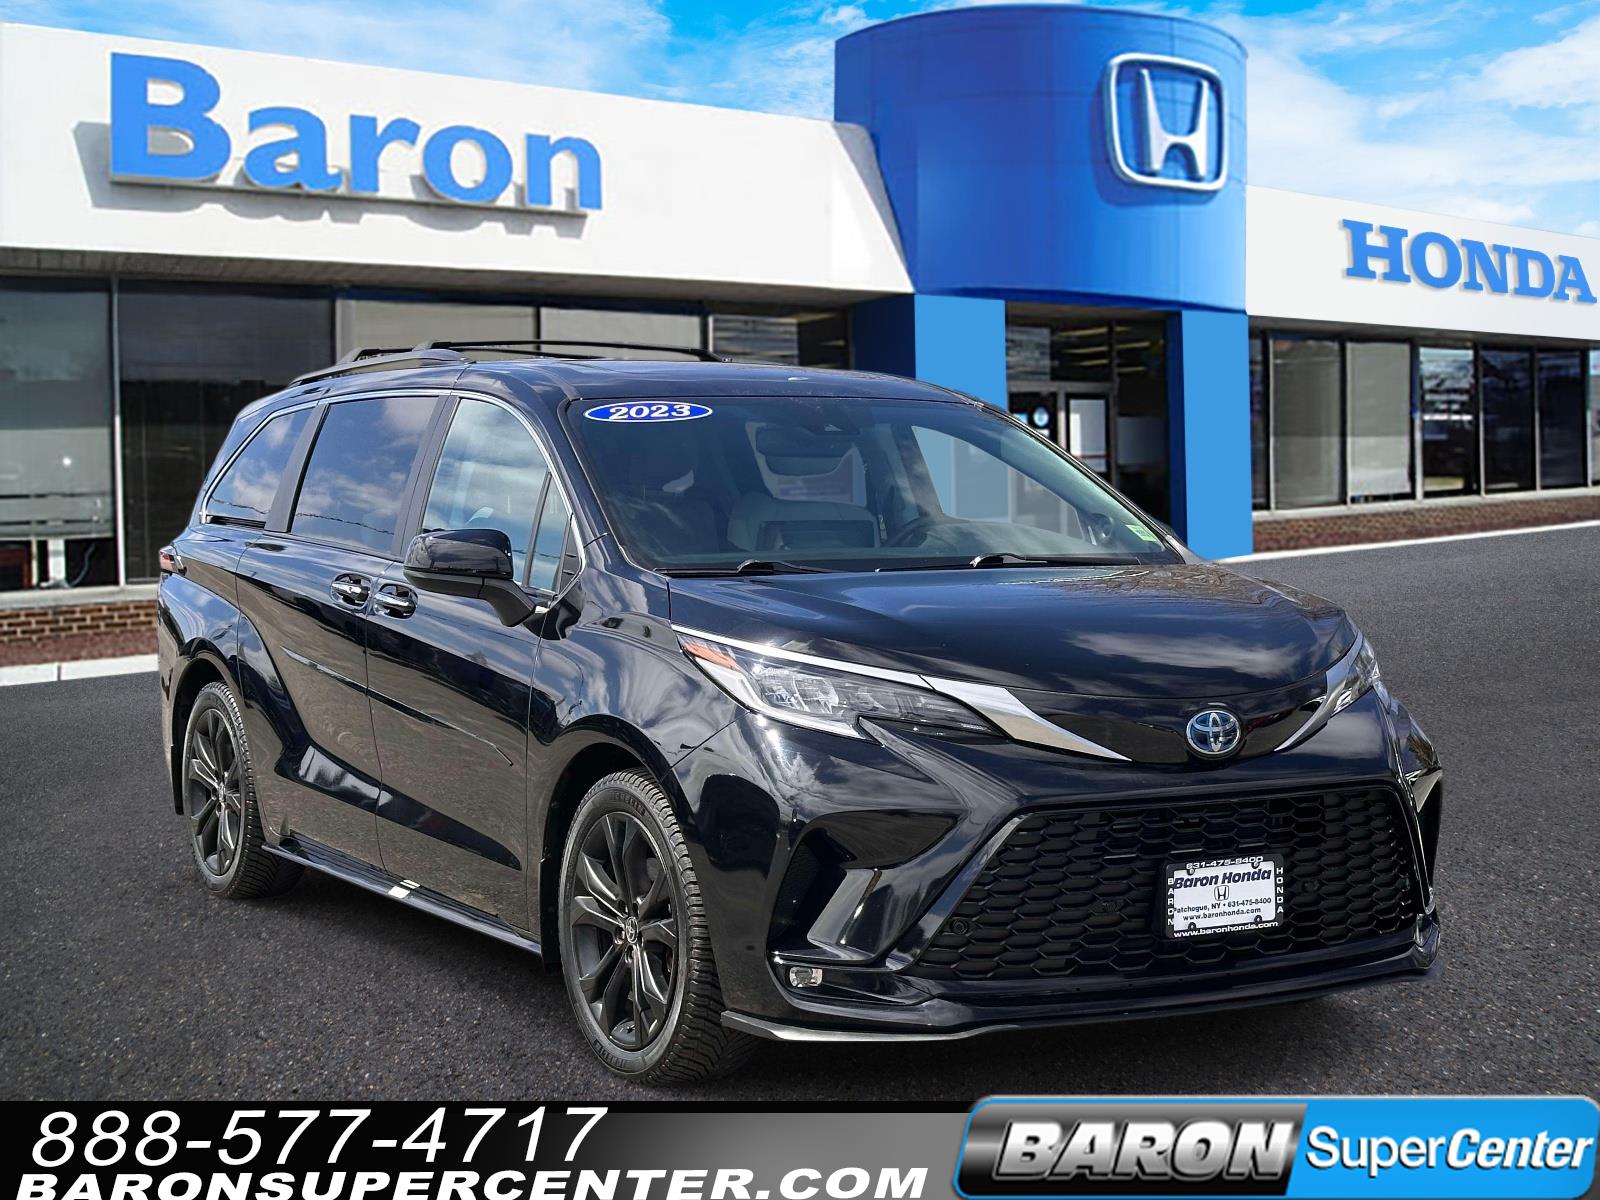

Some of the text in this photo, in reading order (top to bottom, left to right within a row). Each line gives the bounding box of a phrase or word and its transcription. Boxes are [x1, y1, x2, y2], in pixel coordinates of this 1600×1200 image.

[110, 52, 603, 211] Baron
[1342, 219, 1598, 304] HONDA
[608, 404, 691, 420] 2023
[1186, 856, 1264, 870] 631-475-8400
[1174, 868, 1272, 889] Baron Honda
[1276, 867, 1284, 913] HONDA
[1211, 902, 1222, 911] NY
[1227, 897, 1272, 908] 631-475-8400
[1182, 907, 1262, 921] www.baronhonda.com
[1173, 921, 1279, 938] www.baronhonda.com
